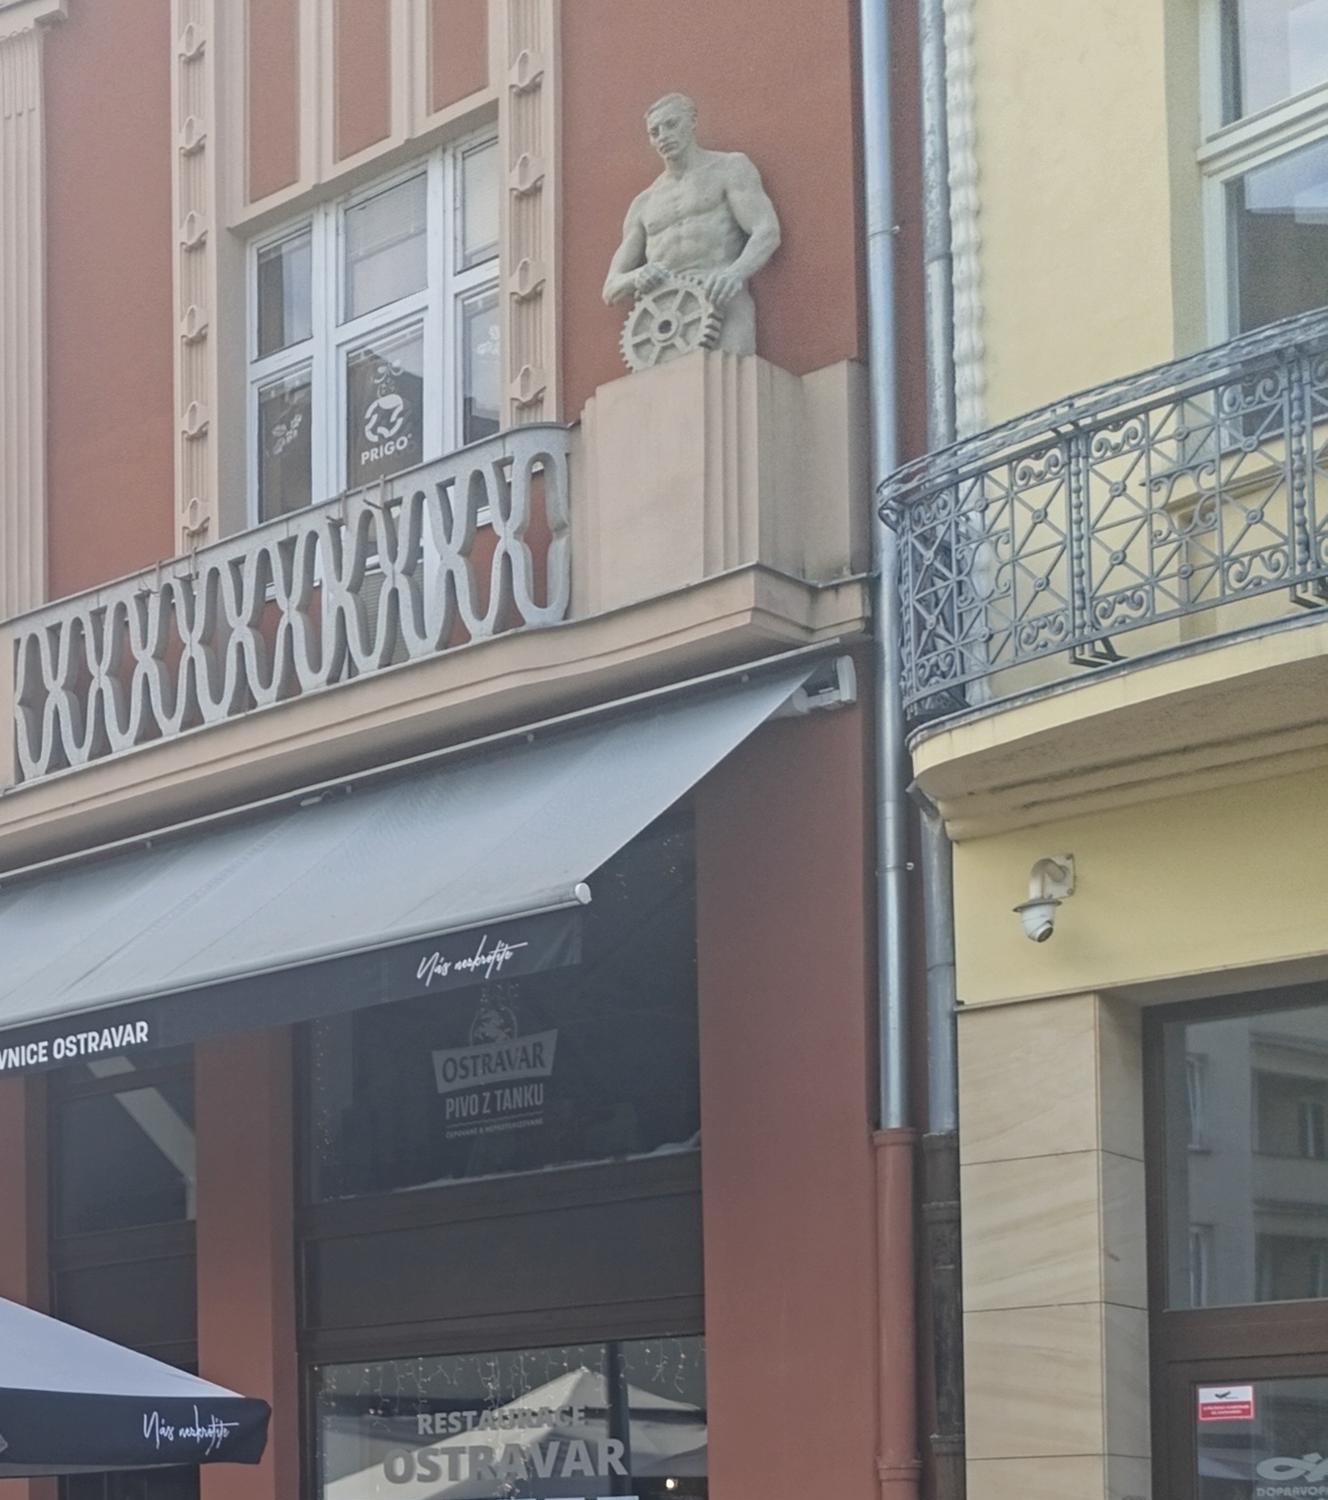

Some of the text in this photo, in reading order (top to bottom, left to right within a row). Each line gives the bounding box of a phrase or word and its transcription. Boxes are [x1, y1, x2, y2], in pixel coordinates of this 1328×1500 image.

[360, 436, 409, 466] PRIGO
[52, 1021, 149, 1060] OSTRAVAR
[442, 1041, 545, 1083] OSTRAVAR
[445, 1083, 544, 1120] PIVO Z TANKU
[417, 1405, 588, 1436] RESTAURACE
[383, 1438, 630, 1485] OSTRAVAR
